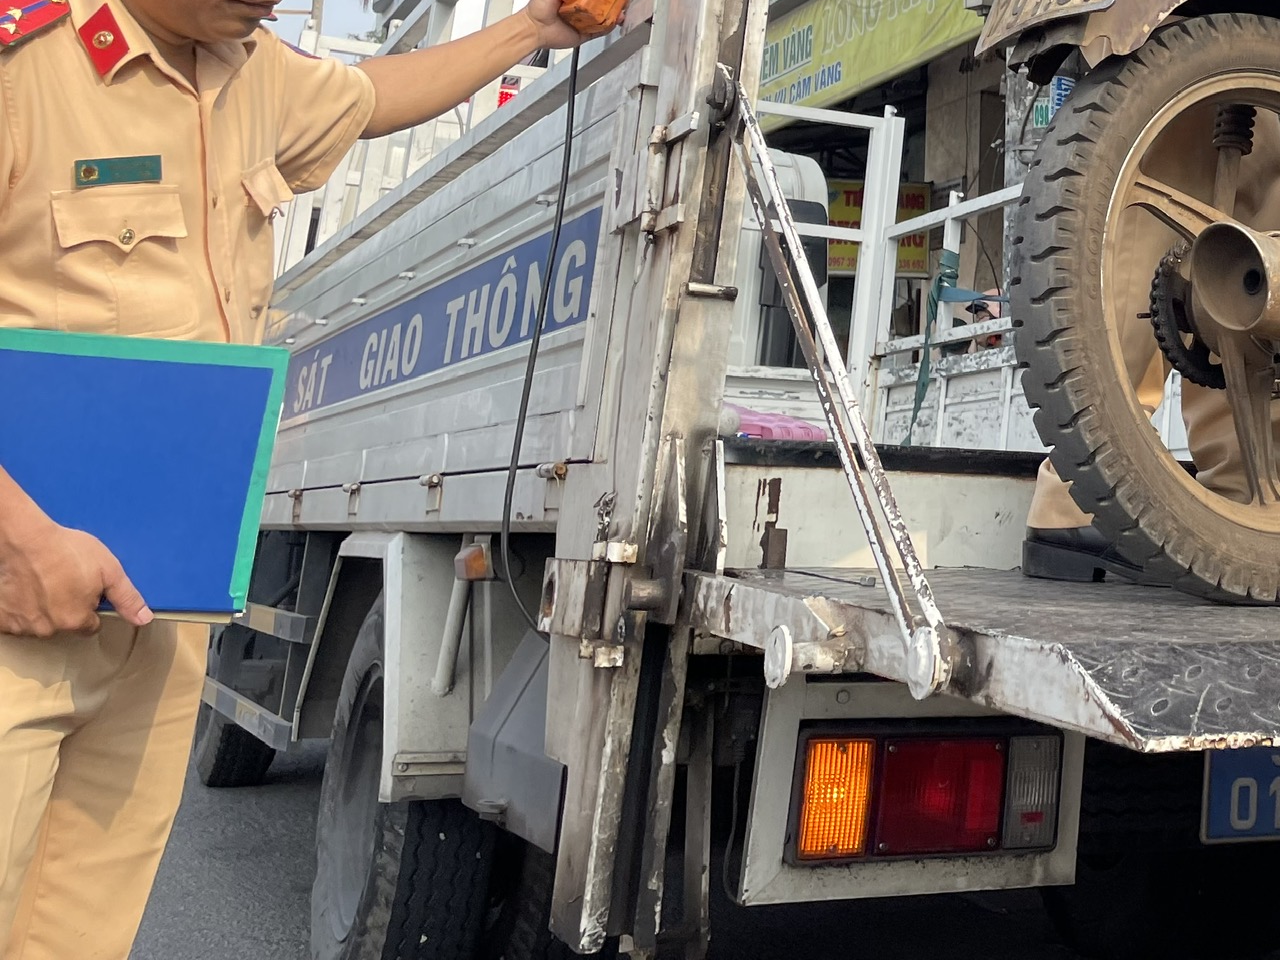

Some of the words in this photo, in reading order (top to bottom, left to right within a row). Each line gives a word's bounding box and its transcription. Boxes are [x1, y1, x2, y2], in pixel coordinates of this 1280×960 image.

[782, 24, 814, 68] VÀNG
[814, 61, 842, 93] VÀNG
[293, 349, 333, 414] SÁT
[359, 313, 424, 390] GIAO
[442, 239, 588, 365] THÔNG
